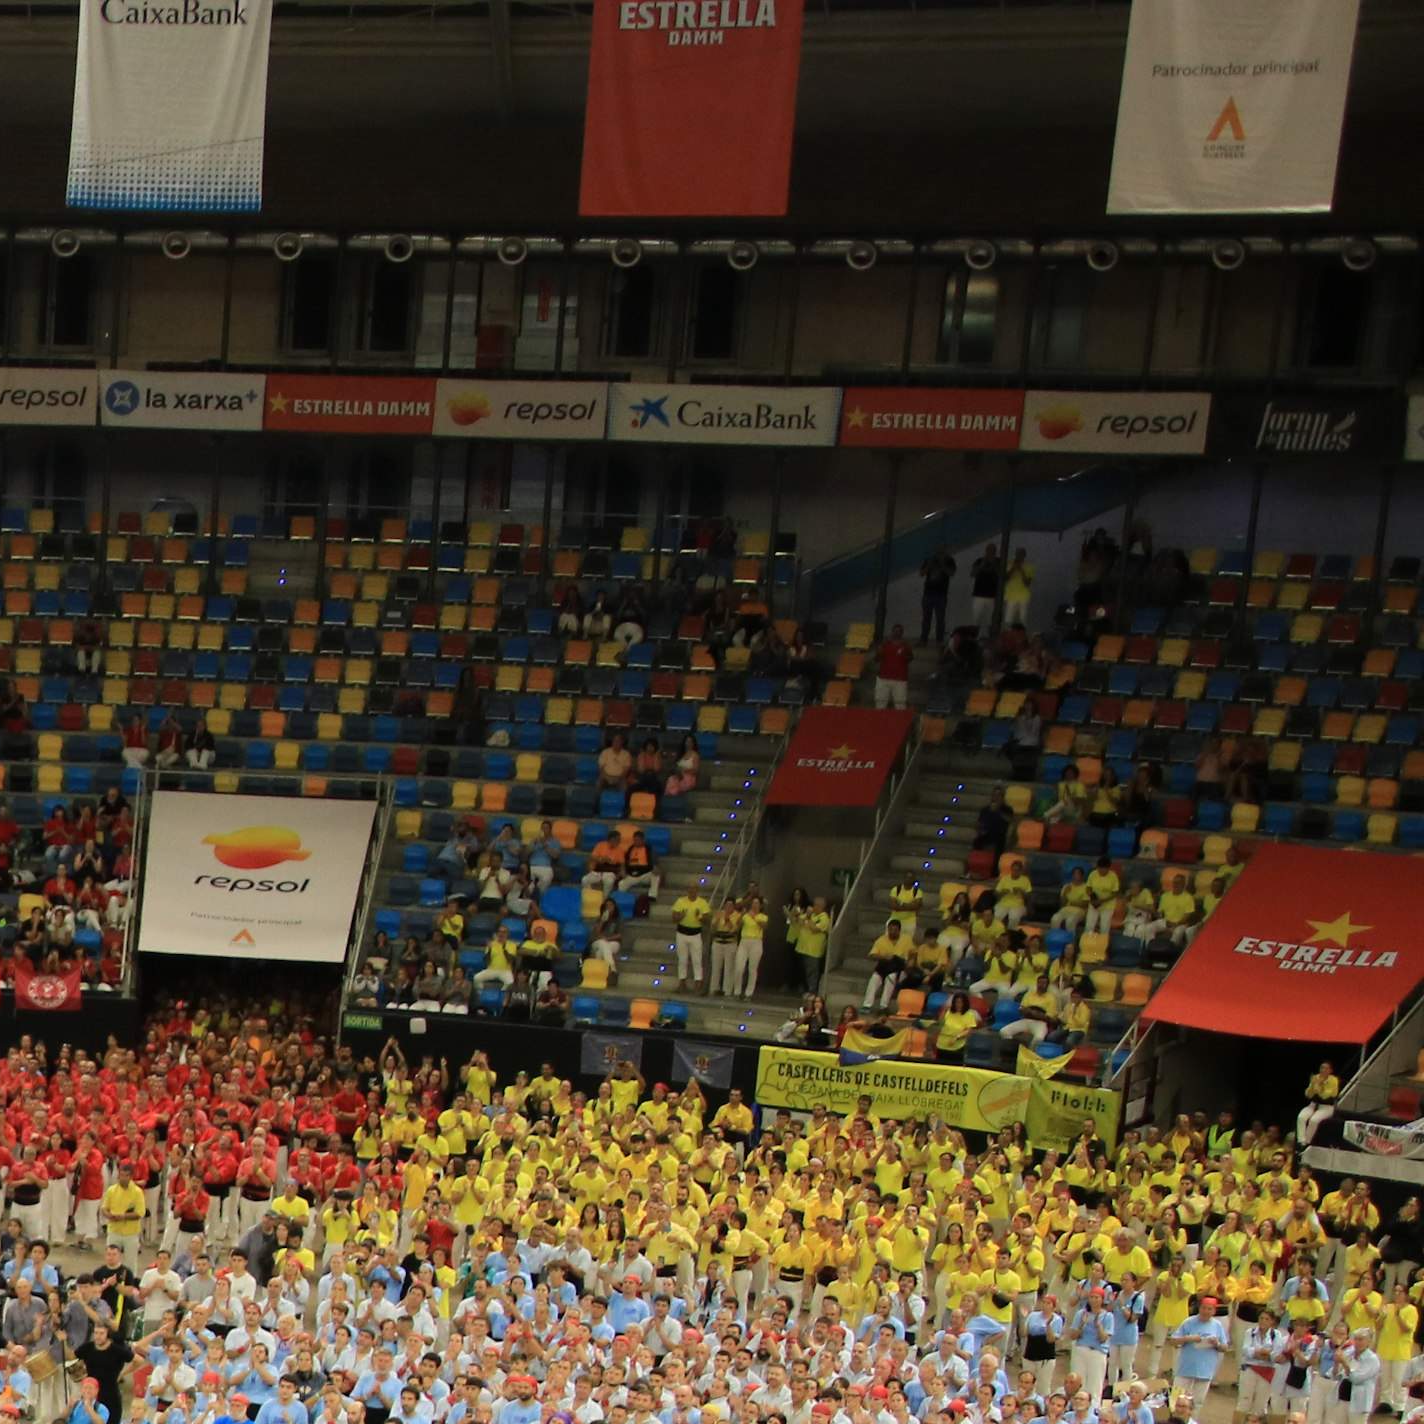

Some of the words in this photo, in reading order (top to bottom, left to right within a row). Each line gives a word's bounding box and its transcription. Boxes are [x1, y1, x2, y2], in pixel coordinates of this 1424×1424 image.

[101, 0, 248, 26] CaixaBank
[619, 0, 777, 30] ESTRELLA
[669, 31, 724, 46] DAMM
[1151, 60, 1250, 78] Patrocinador
[1252, 59, 1320, 77] principal
[145, 388, 167, 409] la
[293, 398, 374, 416] ESTRELLA
[377, 399, 431, 417] DAMM
[503, 399, 597, 424] repsol
[677, 400, 817, 431] CaixaBank
[871, 411, 956, 431] ESTRELLA
[959, 413, 1017, 432] DAMM
[1095, 410, 1198, 438] repsol
[796, 758, 876, 770] ESTRELLA
[194, 874, 311, 893] repsol
[1233, 936, 1398, 968] ESTRELLA
[1278, 960, 1338, 975] DAMM
[777, 1062, 852, 1085] CASTELLERS
[854, 1070, 869, 1086] DE
[873, 1073, 969, 1097] CASTELLDEFELS
